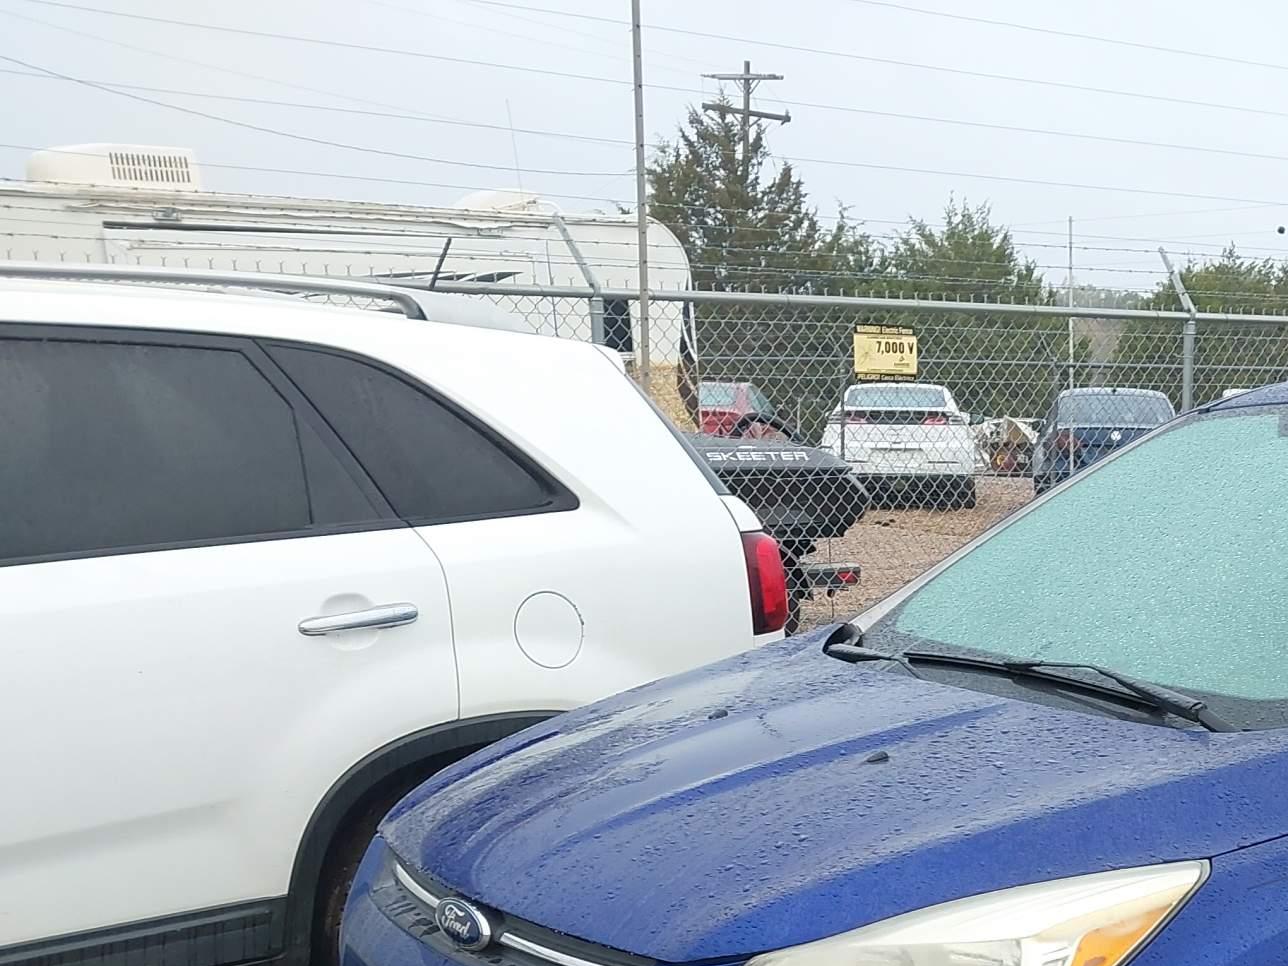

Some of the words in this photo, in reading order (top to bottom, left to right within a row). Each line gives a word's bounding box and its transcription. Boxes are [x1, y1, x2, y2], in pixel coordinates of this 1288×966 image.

[876, 341, 905, 355] 7,000
[907, 342, 915, 355] V
[705, 451, 810, 461] SKEETER
[441, 904, 471, 938] Ford
